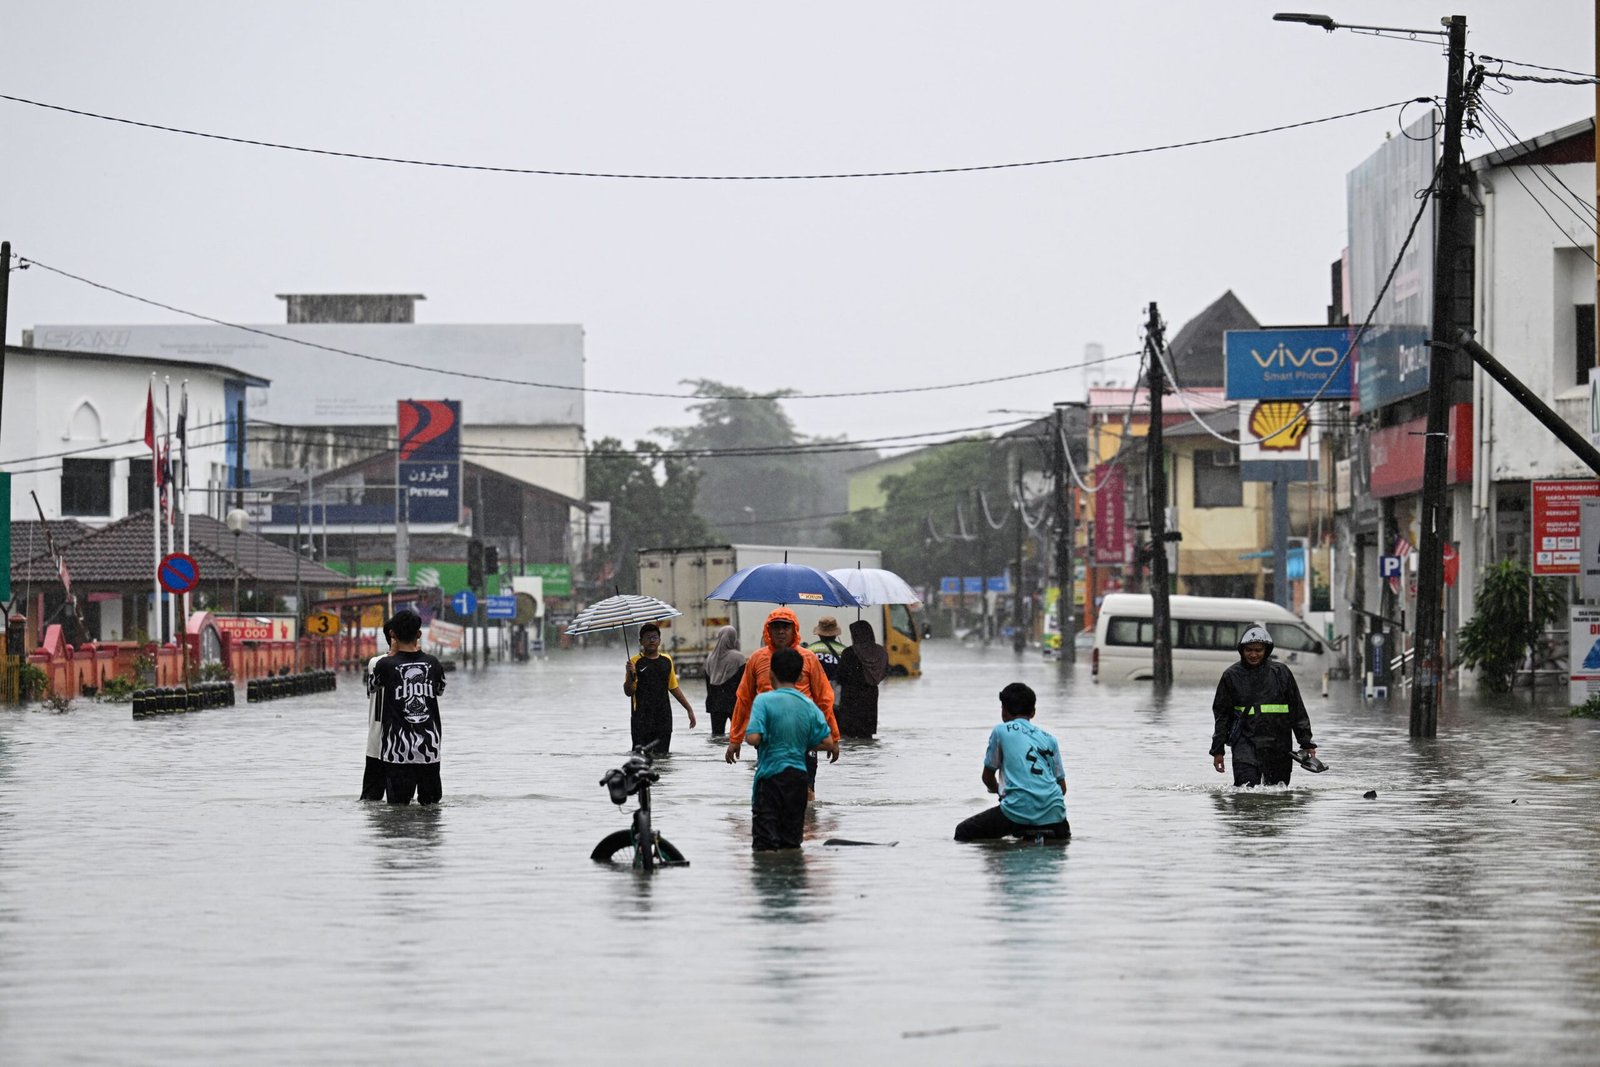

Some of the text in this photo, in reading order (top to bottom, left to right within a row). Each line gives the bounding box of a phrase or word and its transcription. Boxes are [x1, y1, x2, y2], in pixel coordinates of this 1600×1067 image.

[1263, 371, 1328, 381] Smart Phone
[1385, 559, 1399, 576] P
[318, 615, 330, 633] 3
[1006, 723, 1020, 732] FC
